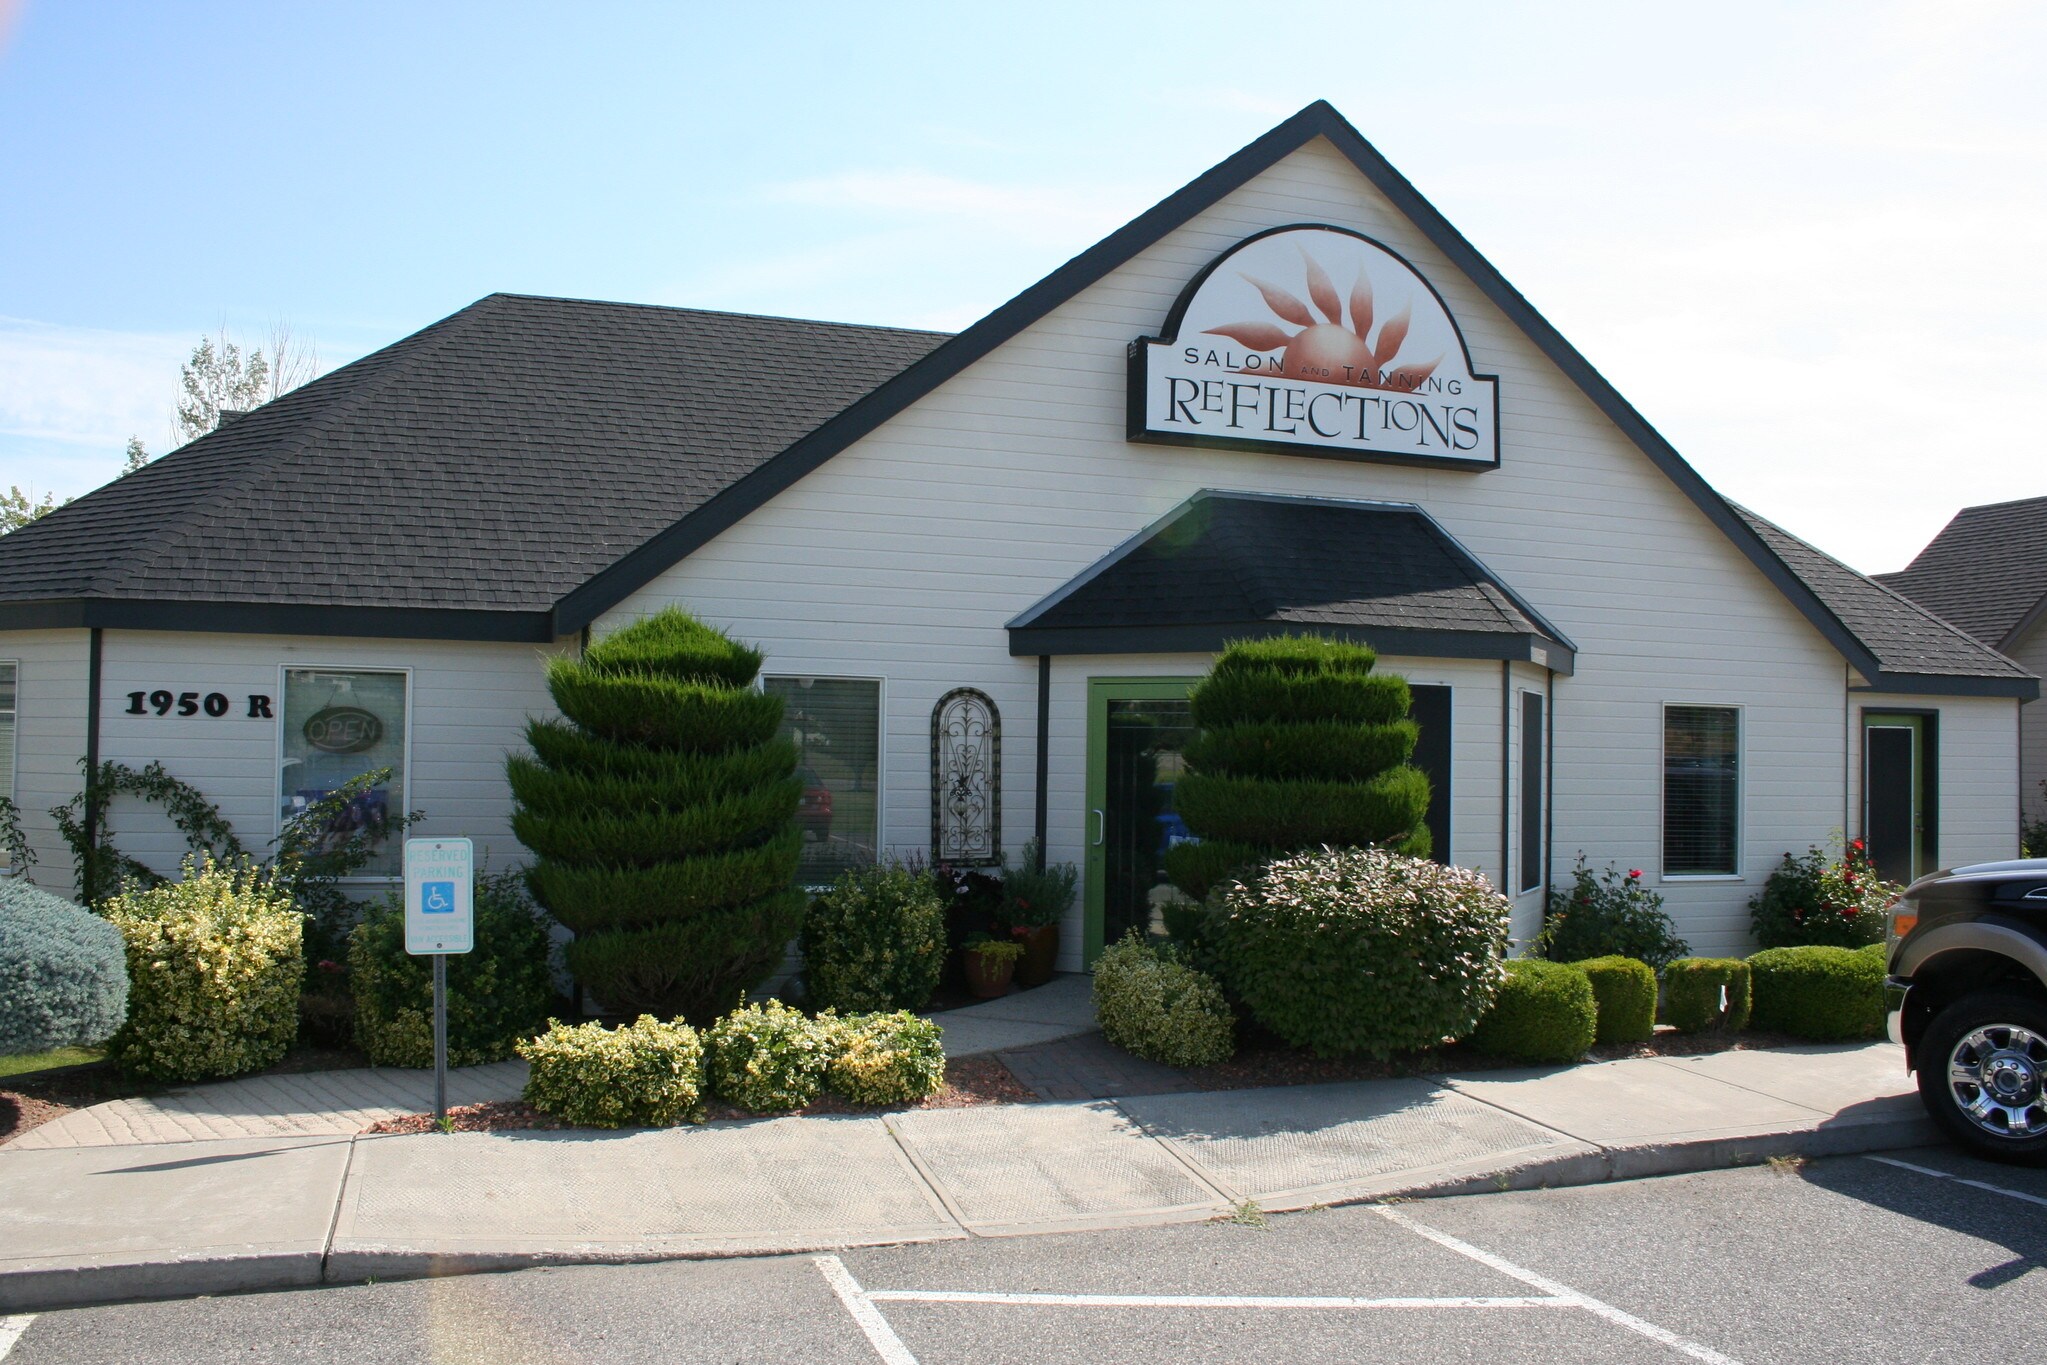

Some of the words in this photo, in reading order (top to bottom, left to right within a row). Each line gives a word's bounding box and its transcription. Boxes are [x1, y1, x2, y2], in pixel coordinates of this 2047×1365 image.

[1184, 347, 1284, 373] SALON
[1301, 366, 1330, 378] AND
[1342, 364, 1463, 396] TANNING
[1163, 375, 1479, 450] REFLECTIONS
[125, 689, 230, 718] 1950
[247, 694, 274, 719] R
[308, 719, 377, 743] OPEN
[409, 849, 468, 862] RESERVED
[413, 865, 465, 879] PARKING
